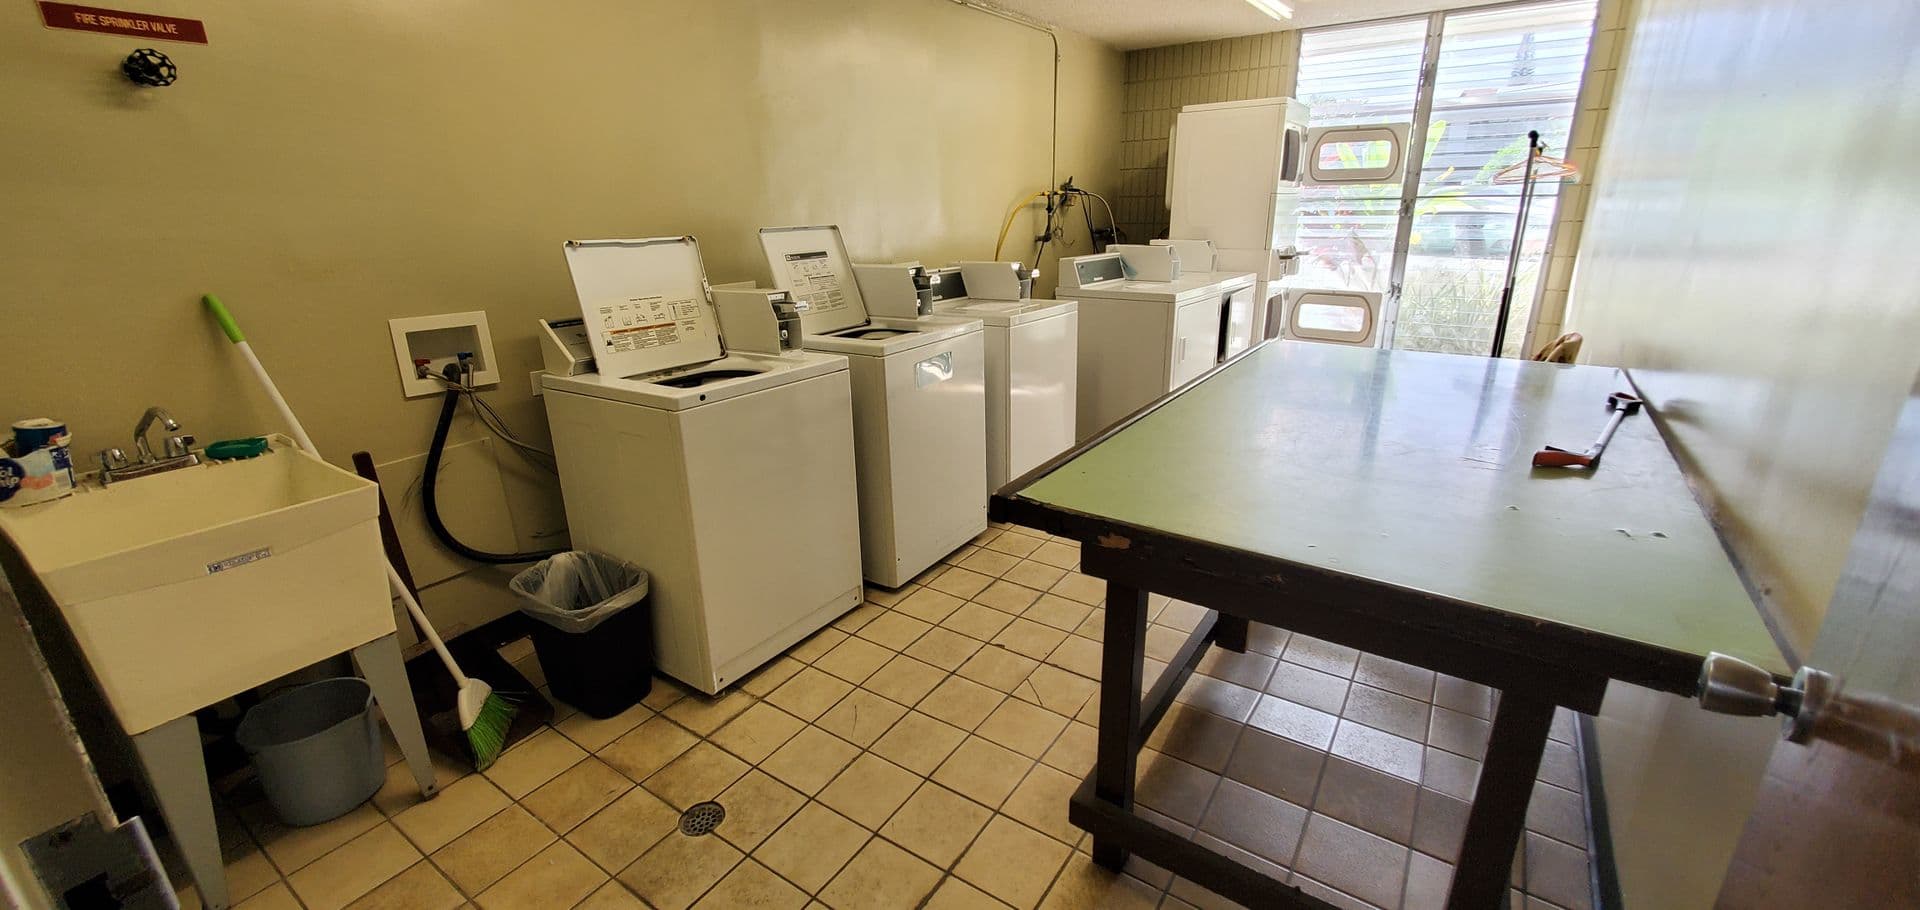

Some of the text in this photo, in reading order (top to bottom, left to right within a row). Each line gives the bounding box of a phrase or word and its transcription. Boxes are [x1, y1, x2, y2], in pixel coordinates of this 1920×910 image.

[74, 12, 179, 34] FIRE SPRINKLER VALVE
[0, 466, 13, 478] ol
